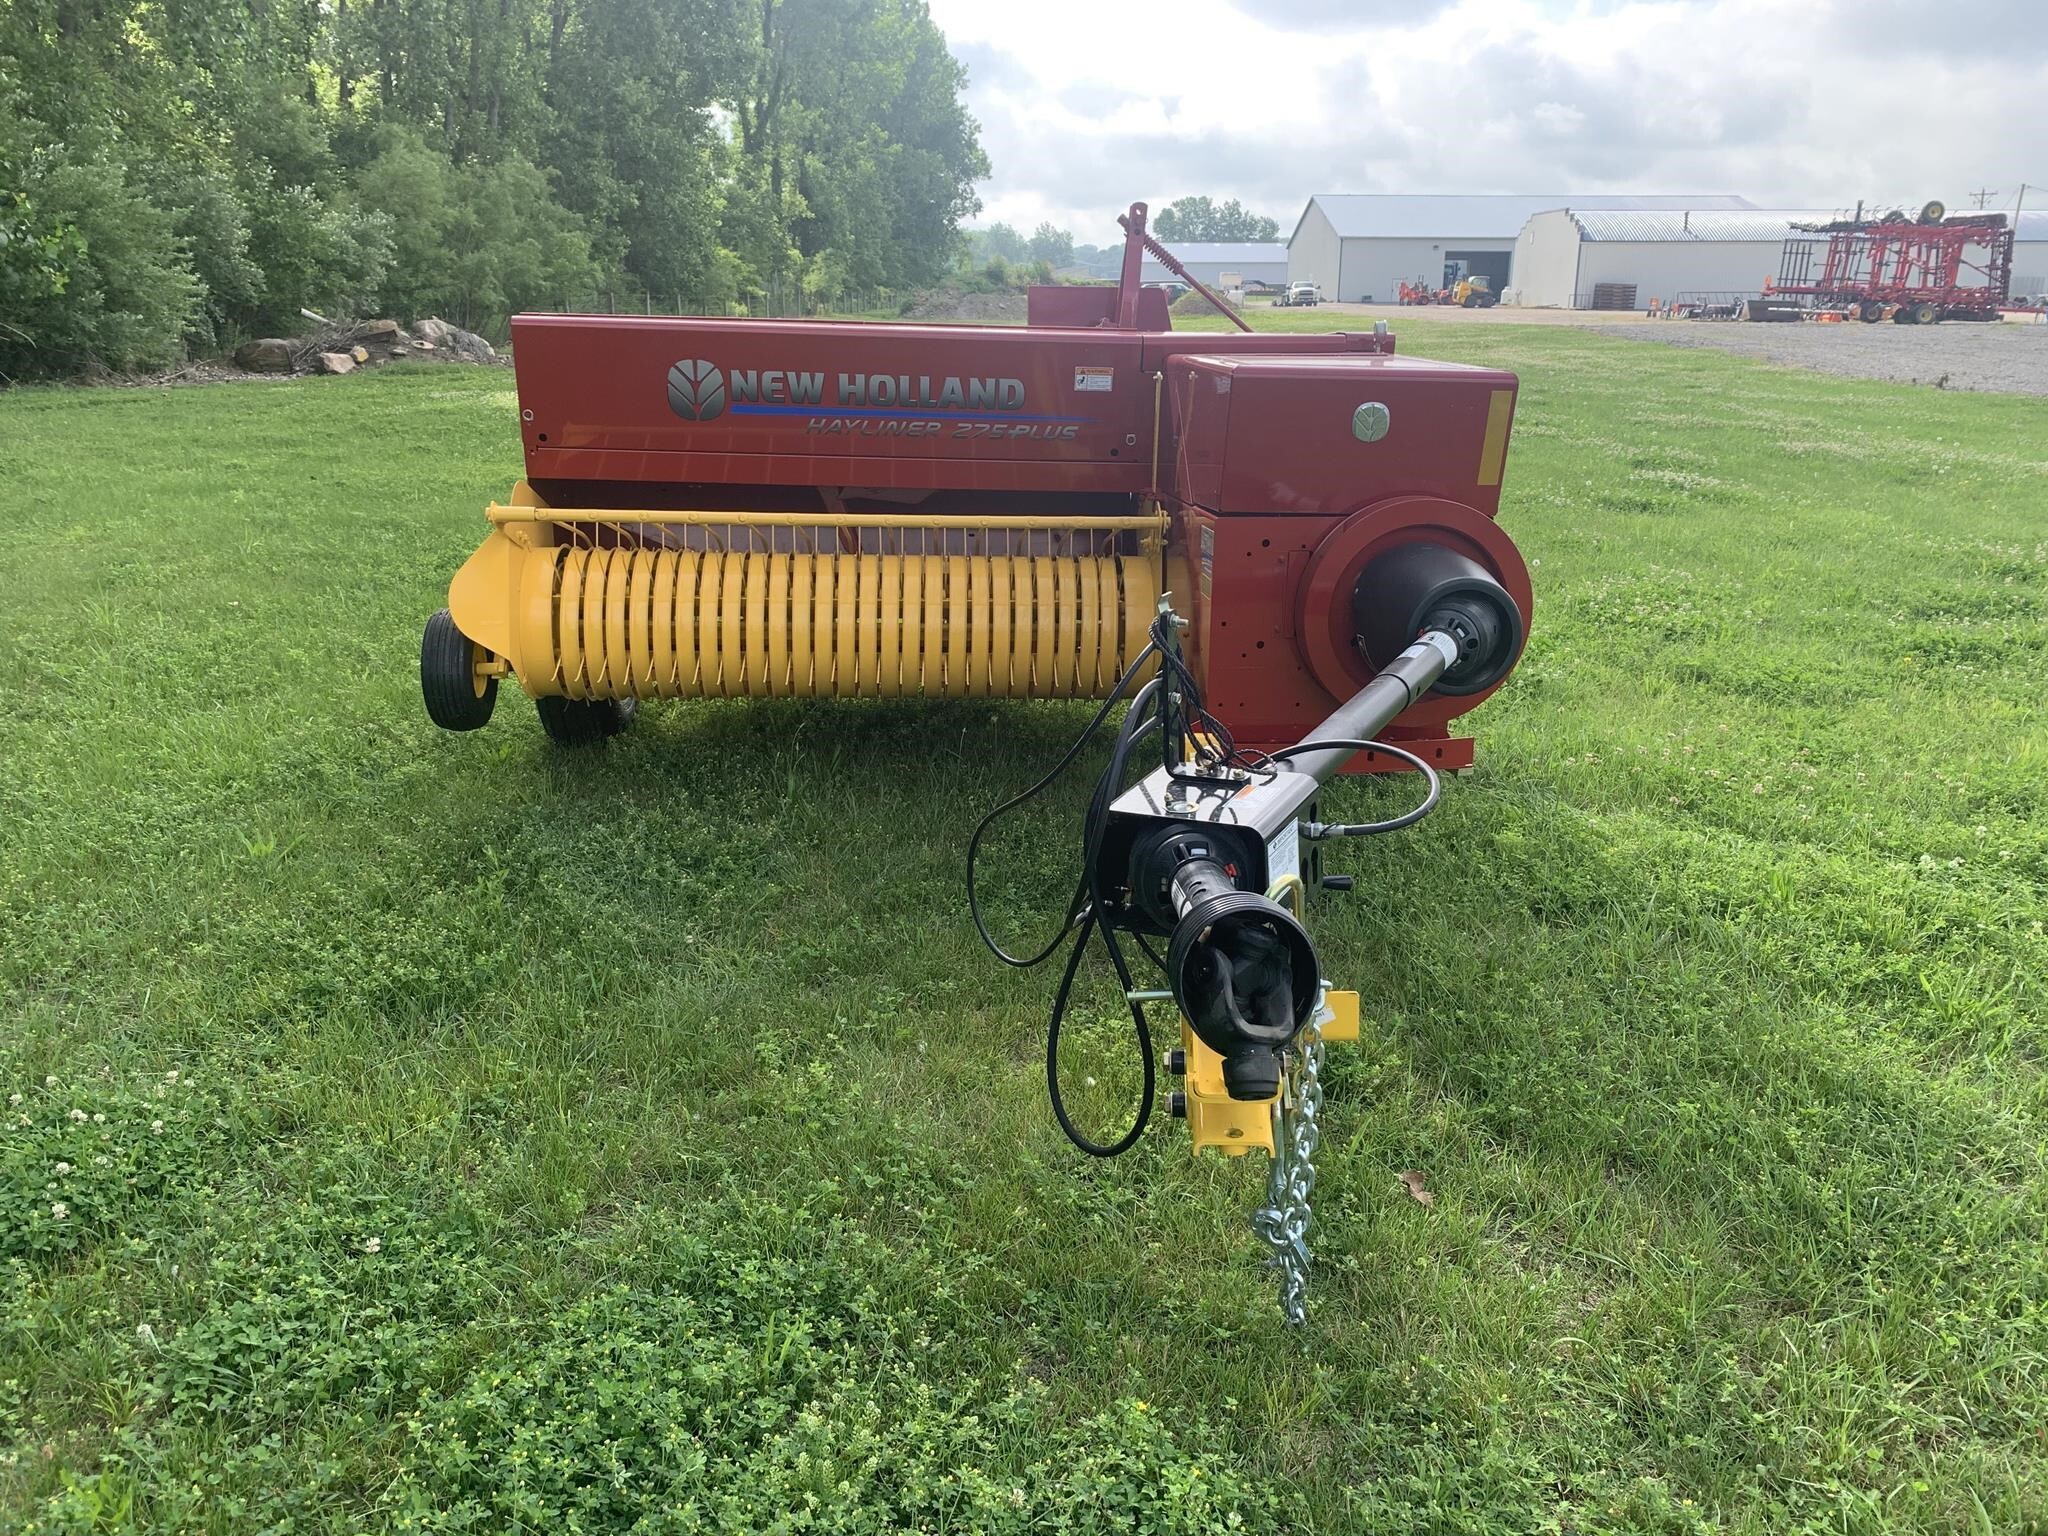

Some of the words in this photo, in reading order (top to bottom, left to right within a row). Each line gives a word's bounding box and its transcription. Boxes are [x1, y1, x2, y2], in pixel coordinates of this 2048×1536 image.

[730, 369, 825, 405] NEW
[838, 373, 1025, 411] HOLLAND
[806, 418, 942, 438] HAYLINER
